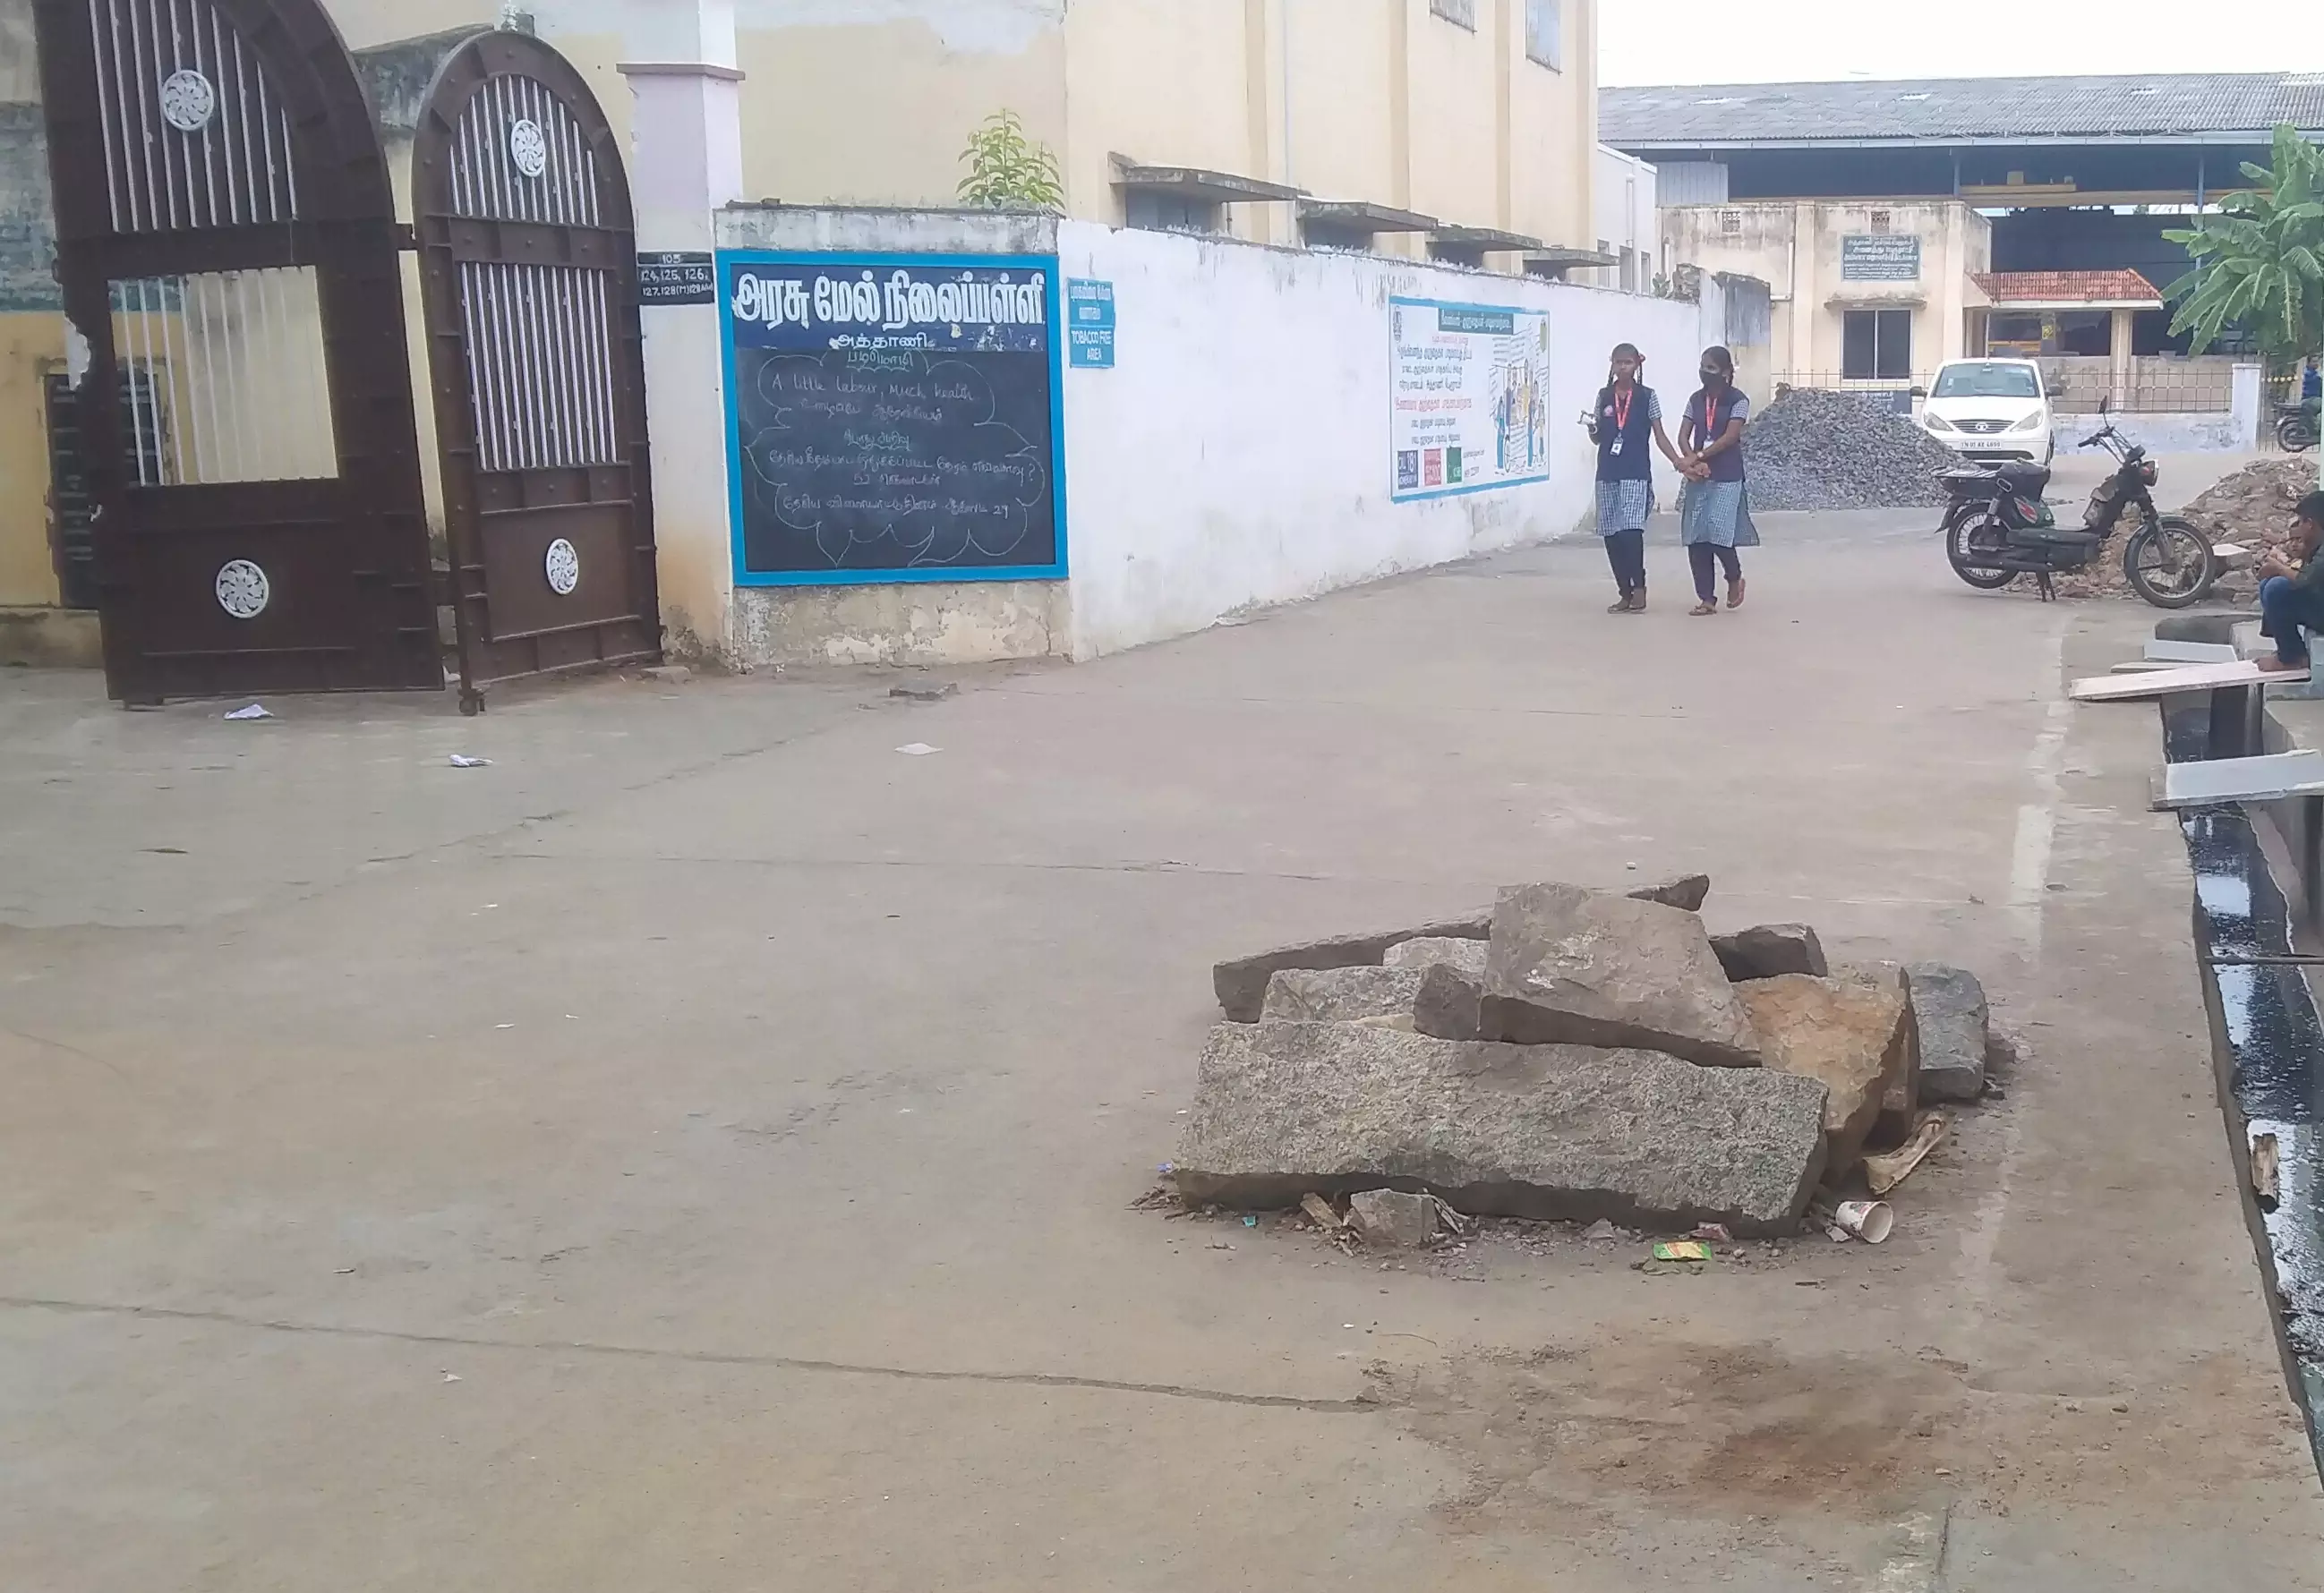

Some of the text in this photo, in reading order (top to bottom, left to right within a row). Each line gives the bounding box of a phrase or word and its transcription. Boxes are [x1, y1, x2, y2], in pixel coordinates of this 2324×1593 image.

[662, 254, 680, 264] 105
[737, 269, 1046, 332] அரசு மேல் நிலைப்பள்ளி
[838, 332, 927, 350] அத்தாணி
[1086, 347, 1102, 360] AREA
[772, 373, 782, 391] A
[793, 373, 826, 391] little
